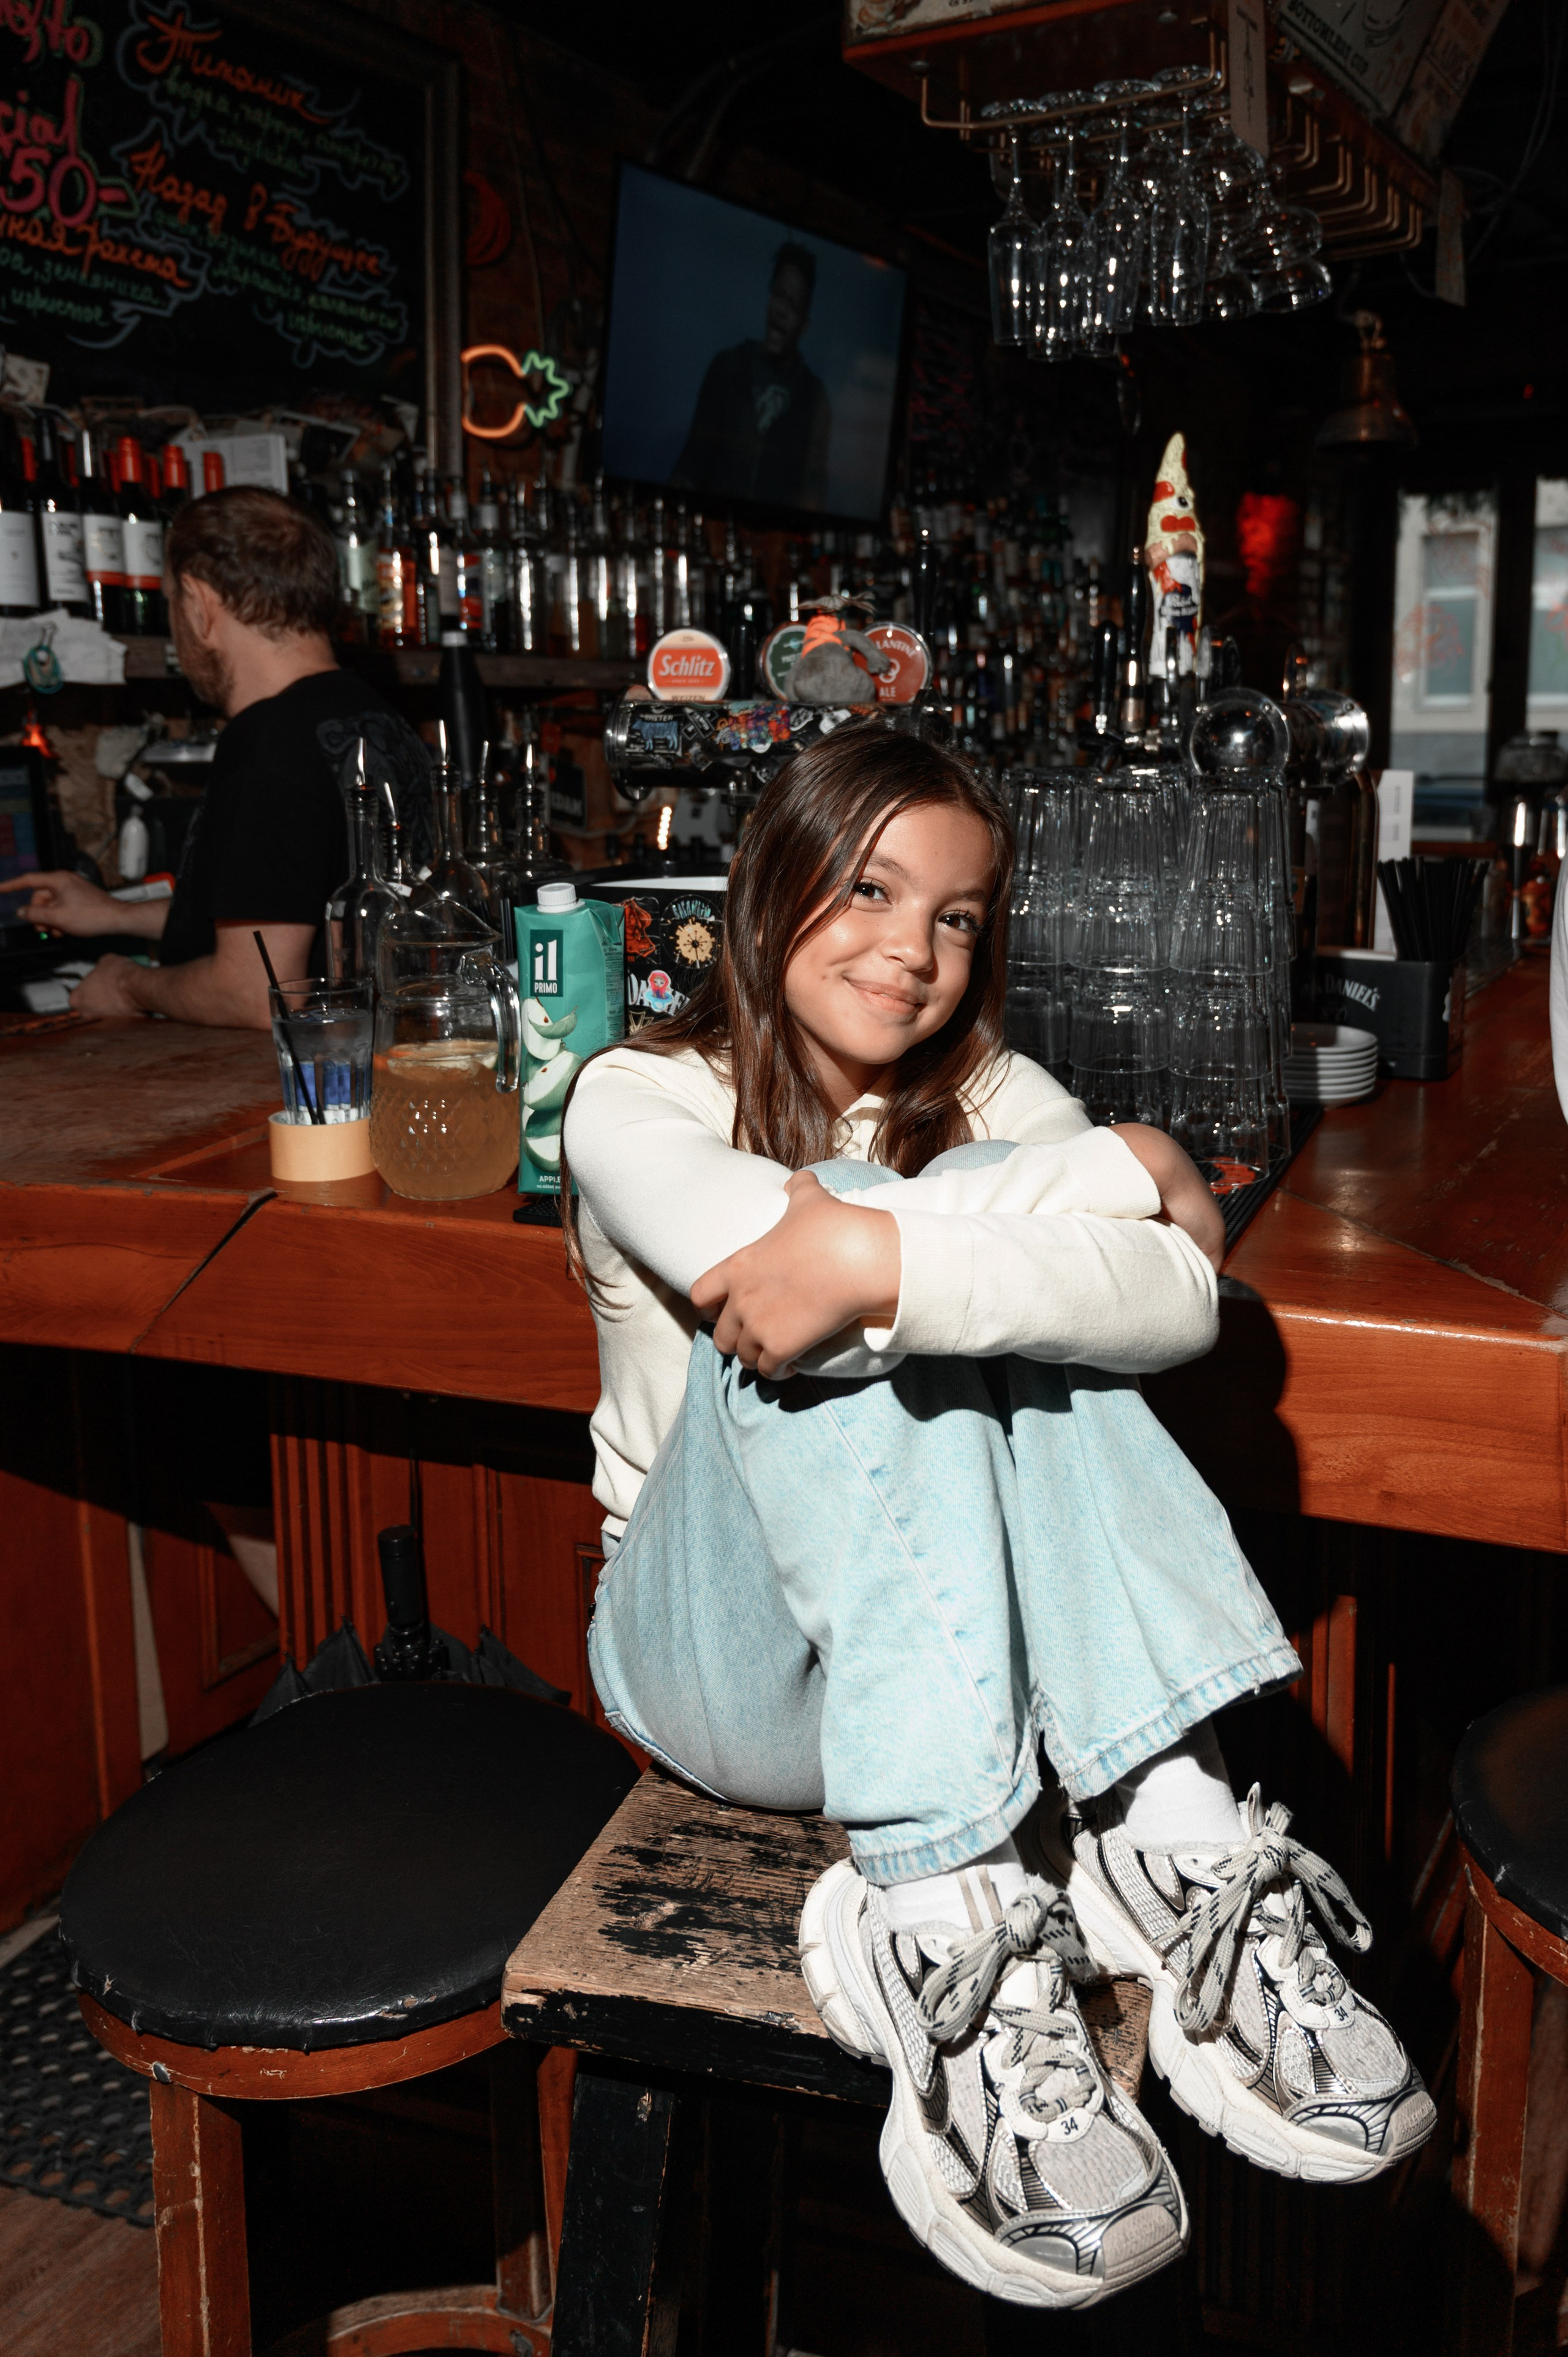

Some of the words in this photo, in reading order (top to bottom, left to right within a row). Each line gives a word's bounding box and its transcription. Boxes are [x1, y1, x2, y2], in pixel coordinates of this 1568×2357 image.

[658, 654, 716, 677] Schlitz
[880, 687, 897, 697] ALE
[533, 939, 558, 981] il
[533, 981, 558, 994] PRIMO
[1334, 2006, 1349, 2022] 34
[1061, 2116, 1079, 2136] 34
